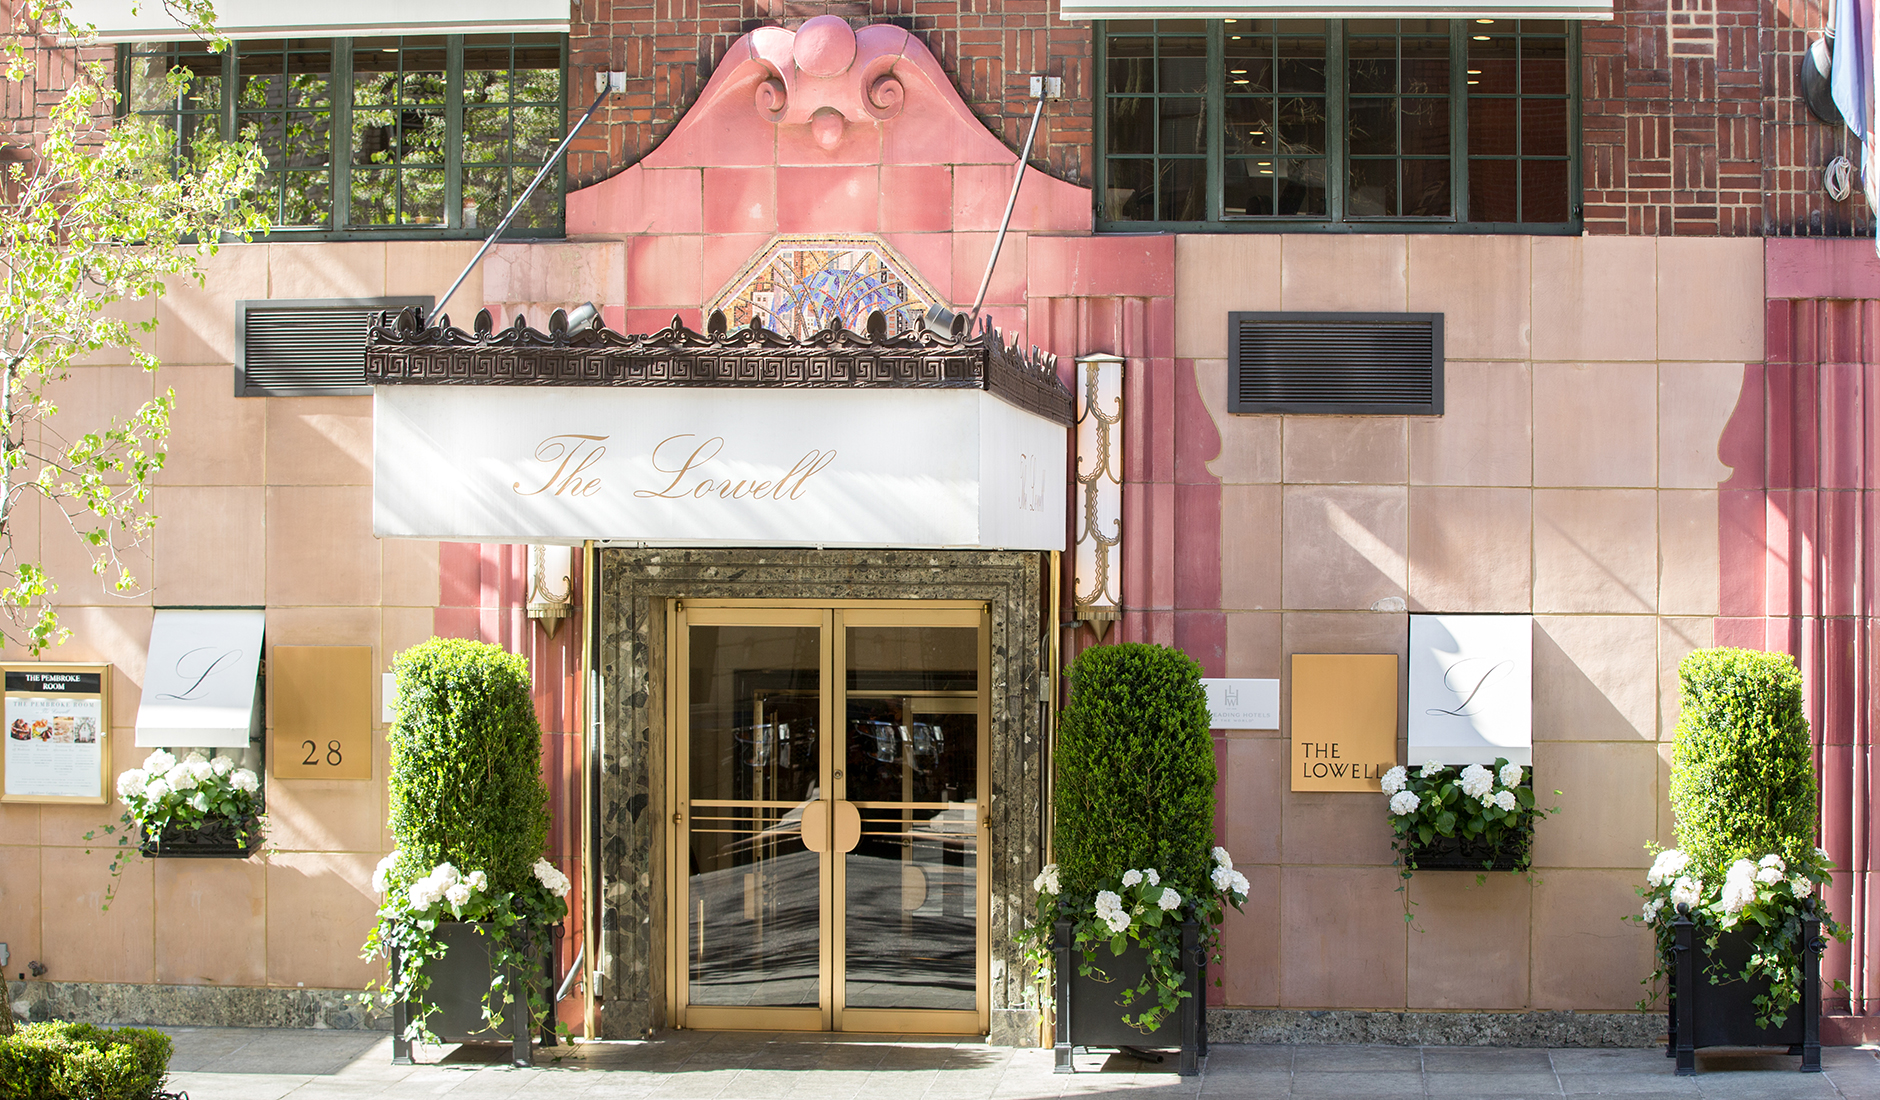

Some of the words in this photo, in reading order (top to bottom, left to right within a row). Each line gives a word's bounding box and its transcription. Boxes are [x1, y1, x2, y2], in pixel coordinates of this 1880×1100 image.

[512, 433, 610, 497] The
[633, 433, 838, 501] Lowell
[25, 674, 40, 682] THE
[40, 674, 81, 682] PEMBROKE
[155, 646, 243, 701] L
[1425, 657, 1515, 717] L
[301, 740, 343, 766] 28
[1301, 742, 1341, 759] THE
[1303, 762, 1384, 779] LOWELL
